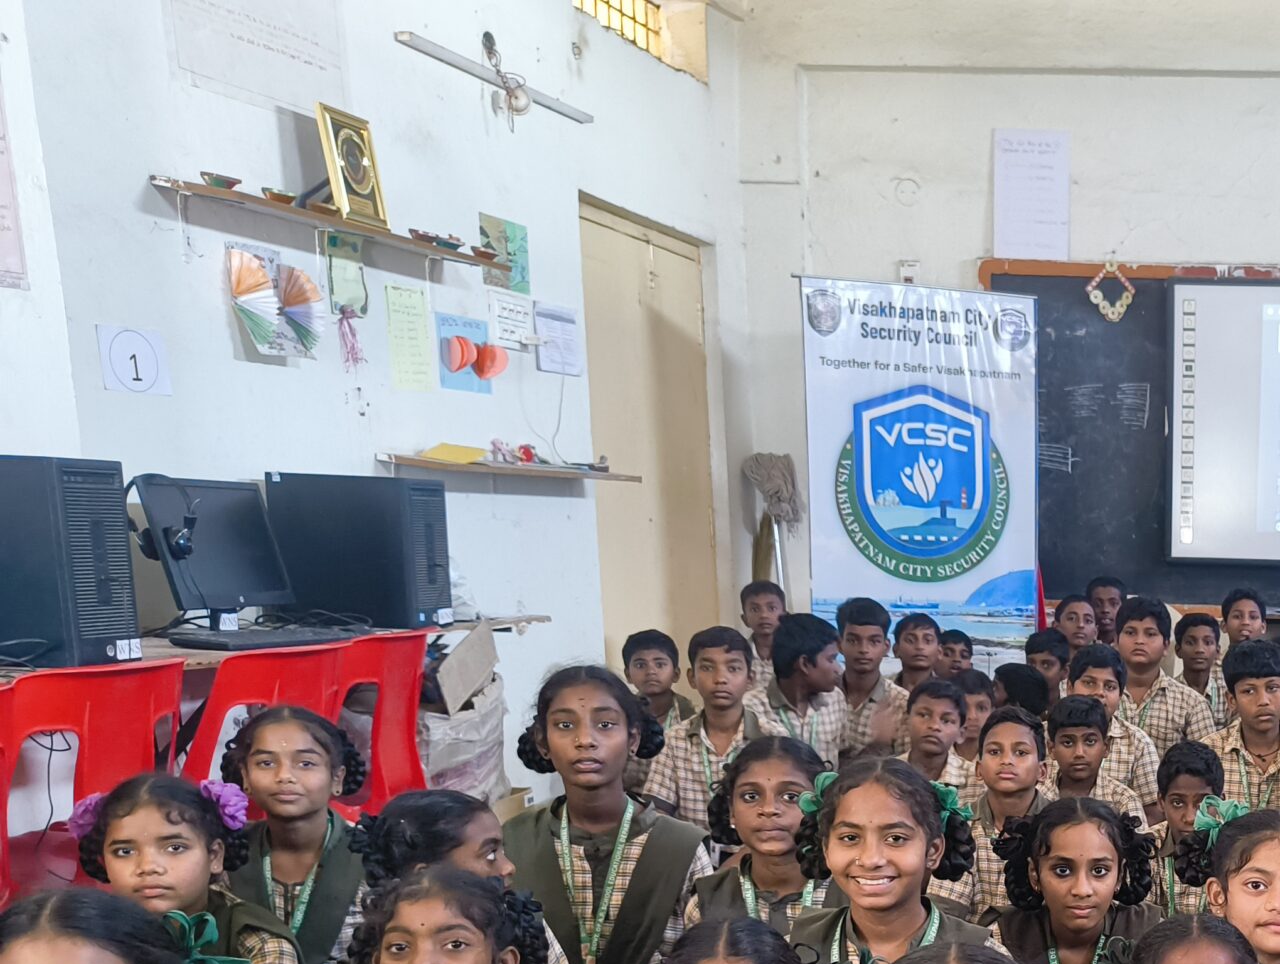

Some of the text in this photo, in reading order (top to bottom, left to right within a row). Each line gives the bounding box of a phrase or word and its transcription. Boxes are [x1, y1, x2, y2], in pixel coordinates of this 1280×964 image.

[848, 298, 961, 325] Visakhapatnam
[860, 323, 978, 348] Security Council
[129, 353, 143, 382] 1
[819, 356, 1021, 381] Together for a Safer Visakhapatnam
[875, 423, 972, 453] VCSC
[835, 459, 1010, 578] VISAKHAPATNAM CITY SECURITY COUNCIL
[608, 842, 623, 885] EDUCATIONAL
